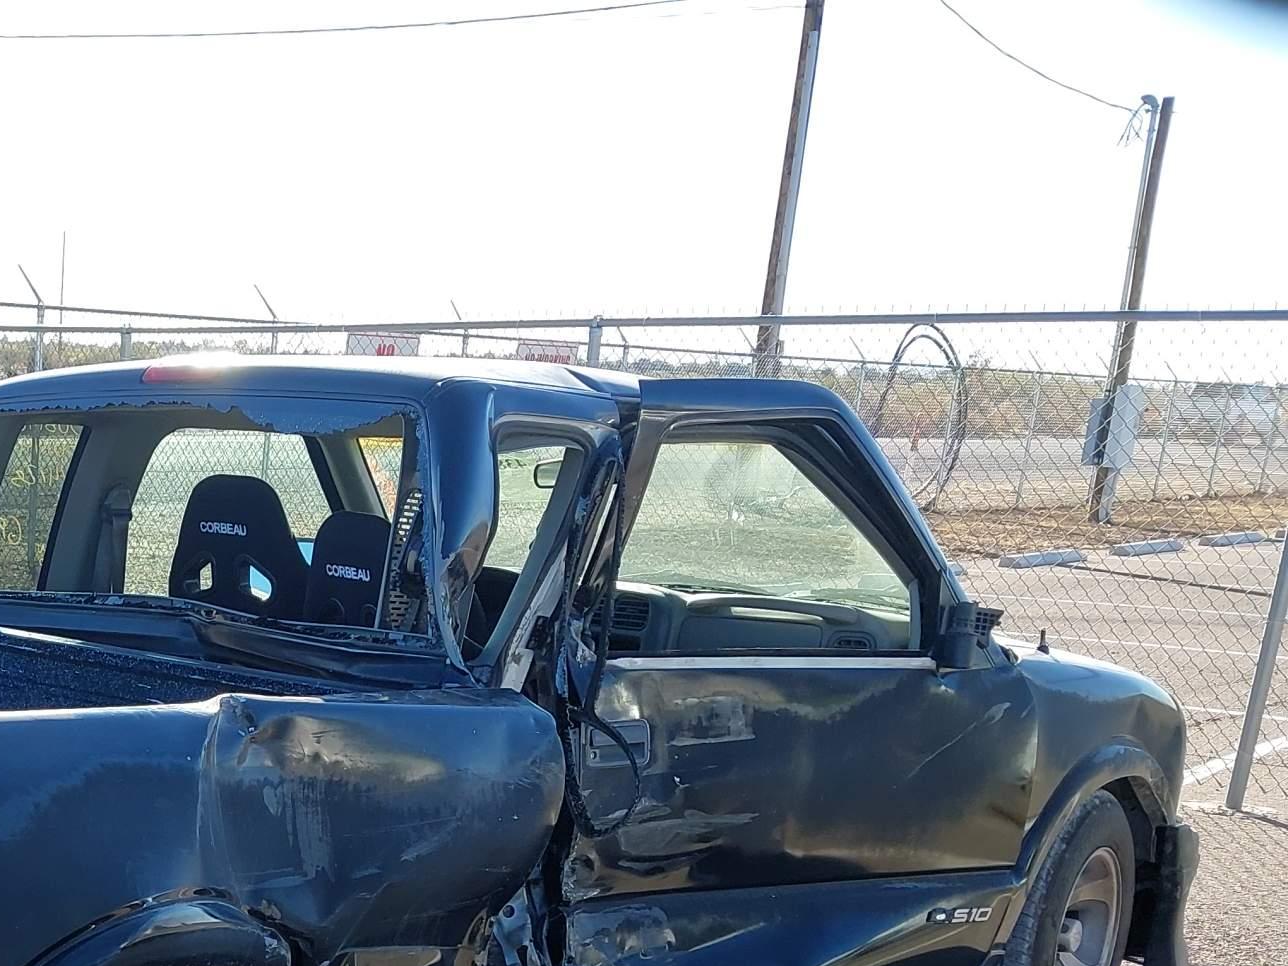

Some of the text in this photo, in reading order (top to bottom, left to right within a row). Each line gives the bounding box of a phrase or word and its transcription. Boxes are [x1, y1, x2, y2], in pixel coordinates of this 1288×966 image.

[200, 521, 247, 537] CORBEAU
[325, 563, 371, 582] CORBEAU
[951, 907, 993, 923] S10
